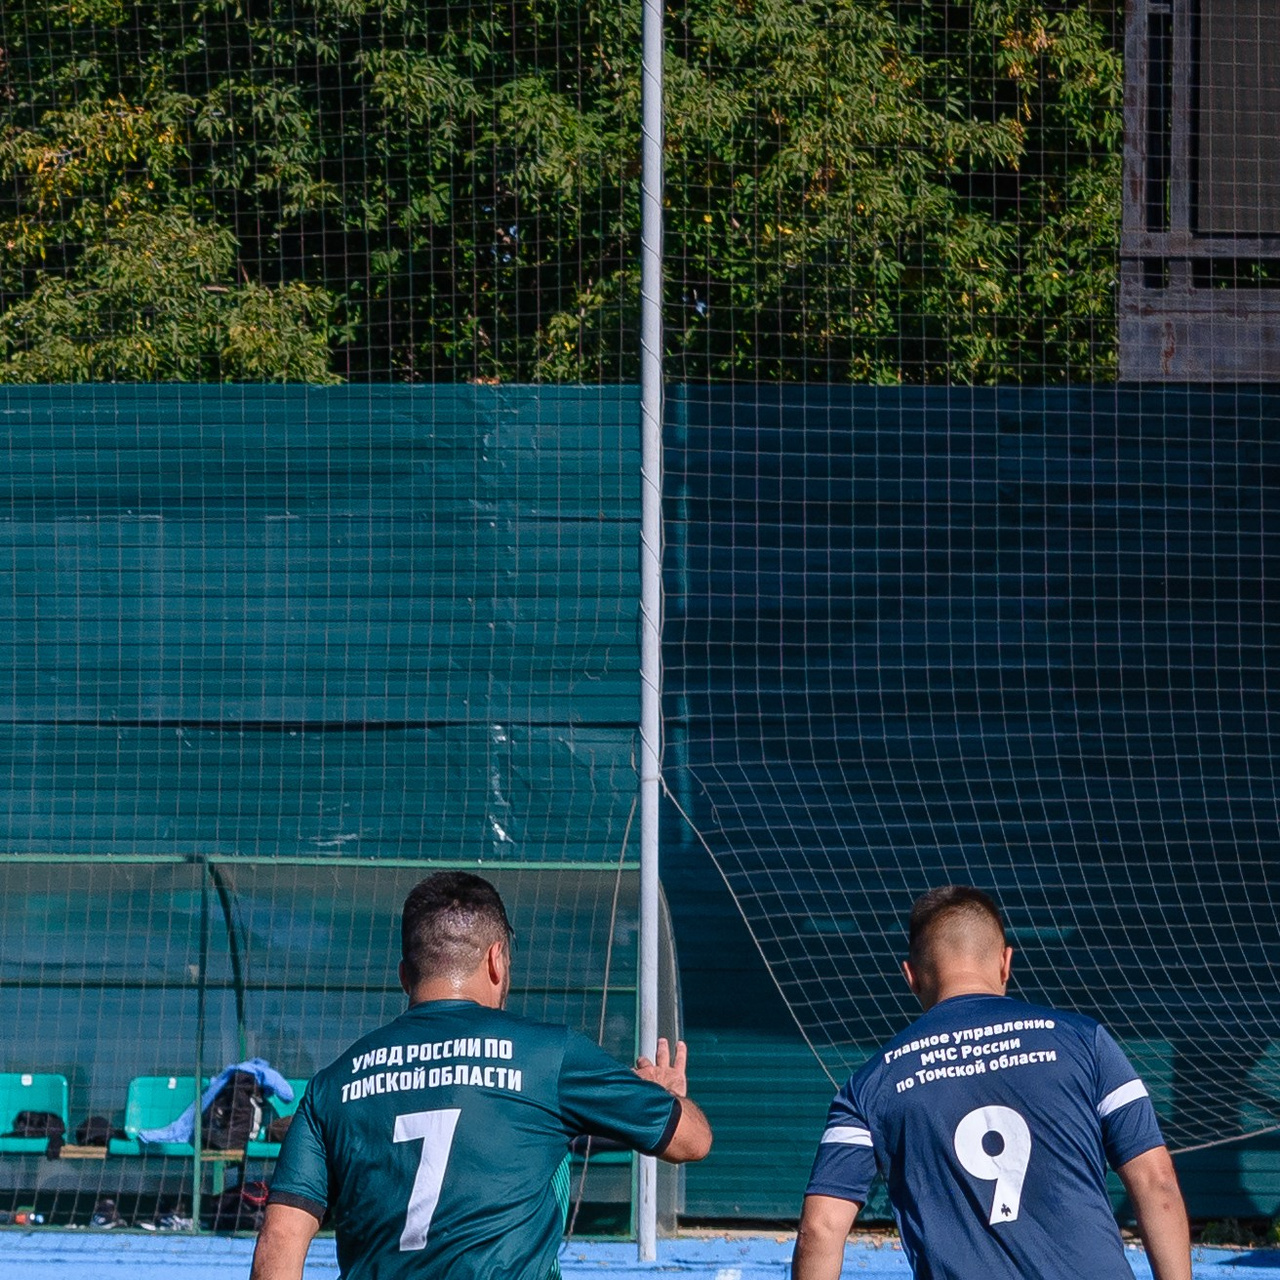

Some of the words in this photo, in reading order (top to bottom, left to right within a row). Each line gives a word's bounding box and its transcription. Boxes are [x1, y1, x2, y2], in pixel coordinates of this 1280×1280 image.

[351, 1045, 404, 1074] УМВД
[406, 1038, 481, 1064] РОССИИ
[484, 1038, 513, 1060] ПО
[884, 1033, 950, 1064] Главное
[952, 1019, 1056, 1044] управление
[920, 1047, 958, 1066] МЧС
[961, 1037, 1021, 1059] России
[341, 1067, 426, 1103] ТОМСКОЙ
[428, 1064, 522, 1092] ОБЛАСТИ
[896, 1077, 915, 1093] по
[916, 1059, 986, 1085] Томской
[989, 1050, 1057, 1071] области
[392, 1108, 462, 1251] 7
[953, 1104, 1032, 1226] 9
